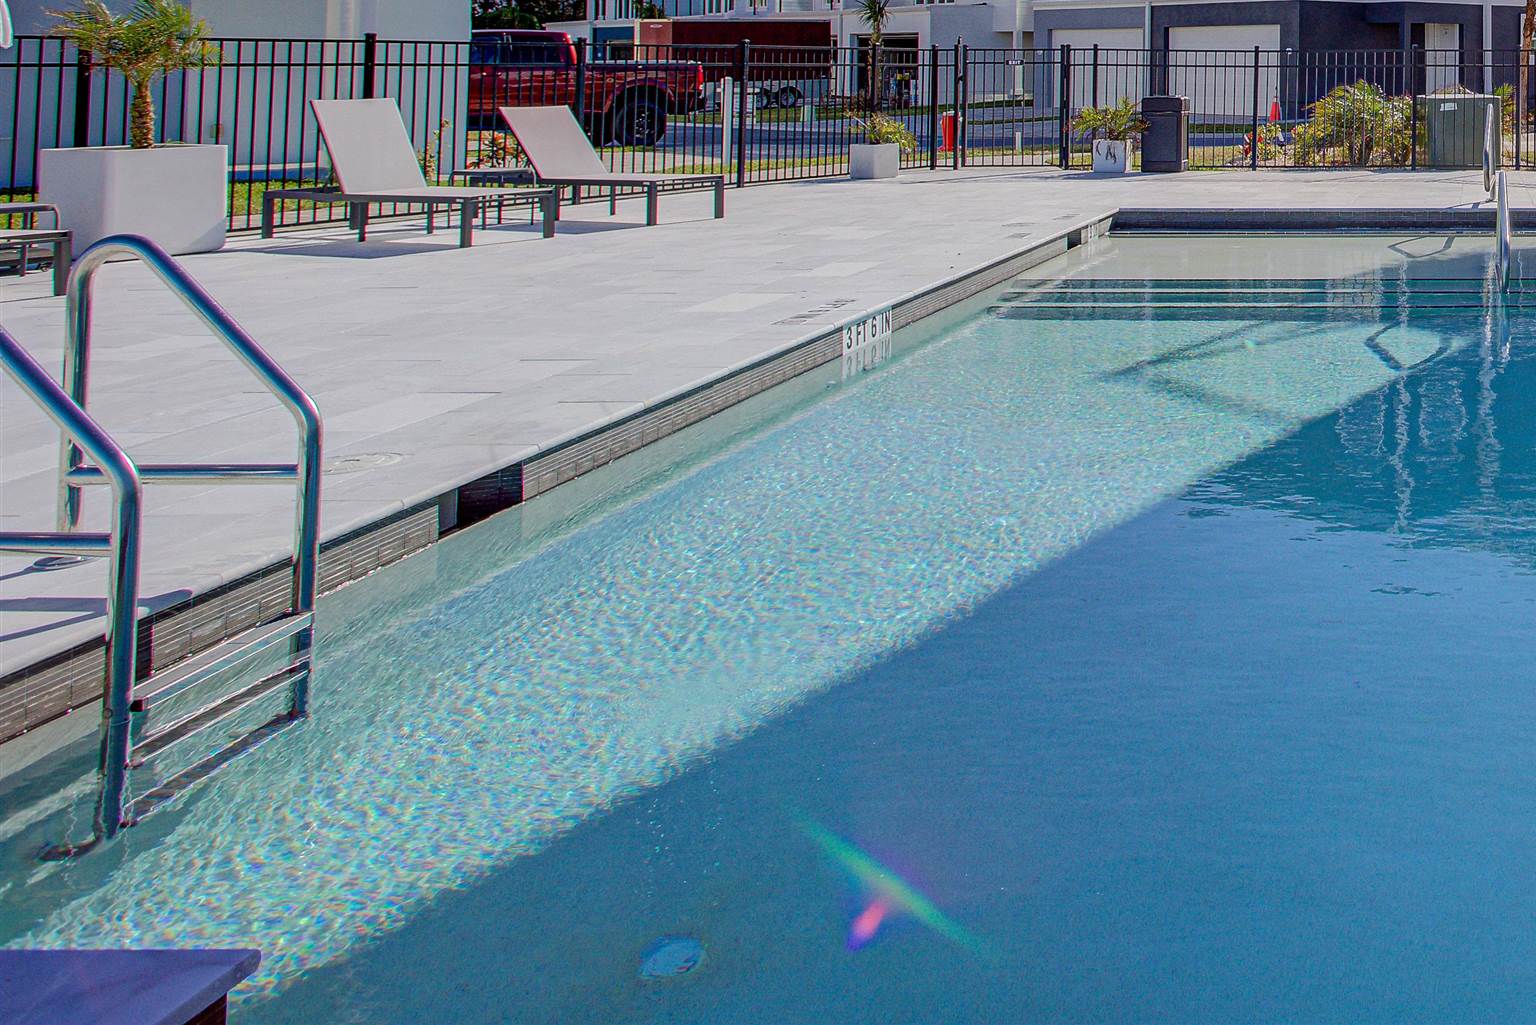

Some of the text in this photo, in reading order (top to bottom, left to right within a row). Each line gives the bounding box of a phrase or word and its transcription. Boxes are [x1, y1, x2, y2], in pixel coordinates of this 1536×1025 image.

[847, 326, 853, 350] 3
[856, 320, 868, 346] FT
[871, 316, 877, 338] 6
[881, 310, 891, 334] IN
